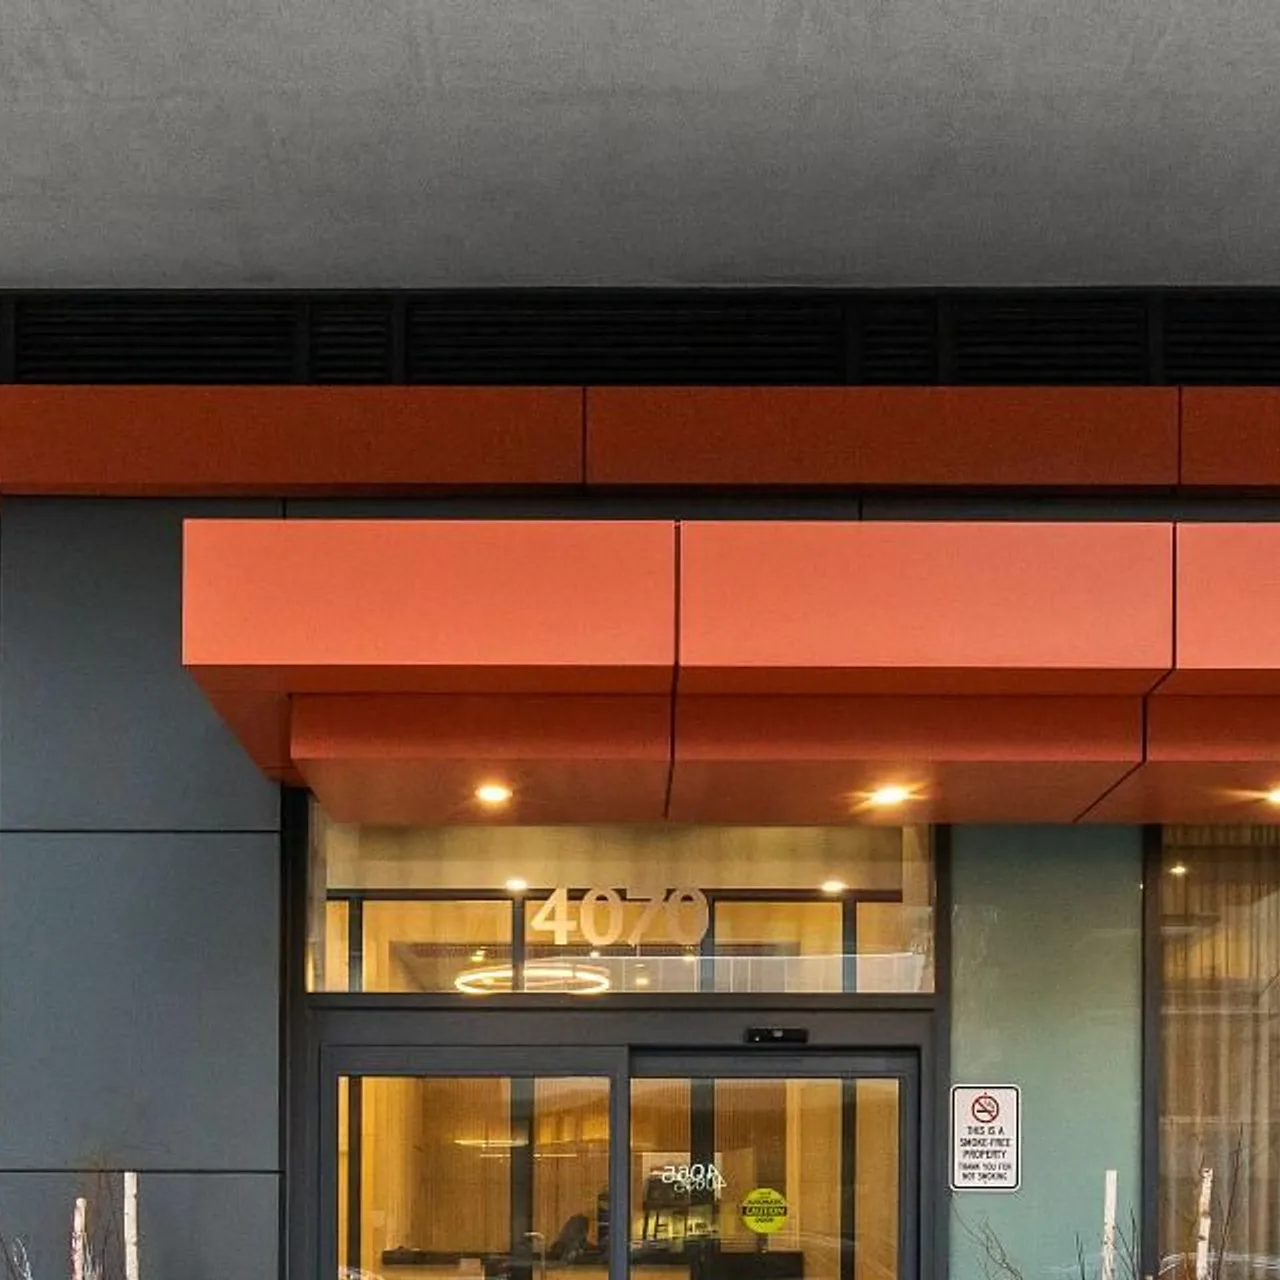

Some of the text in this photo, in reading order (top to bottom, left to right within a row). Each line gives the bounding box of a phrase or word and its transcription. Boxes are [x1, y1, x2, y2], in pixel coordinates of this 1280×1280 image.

[531, 886, 709, 947] 4070
[967, 1126, 985, 1135] THIS
[998, 1126, 1005, 1135] A
[963, 1150, 1007, 1159] PROPERTY
